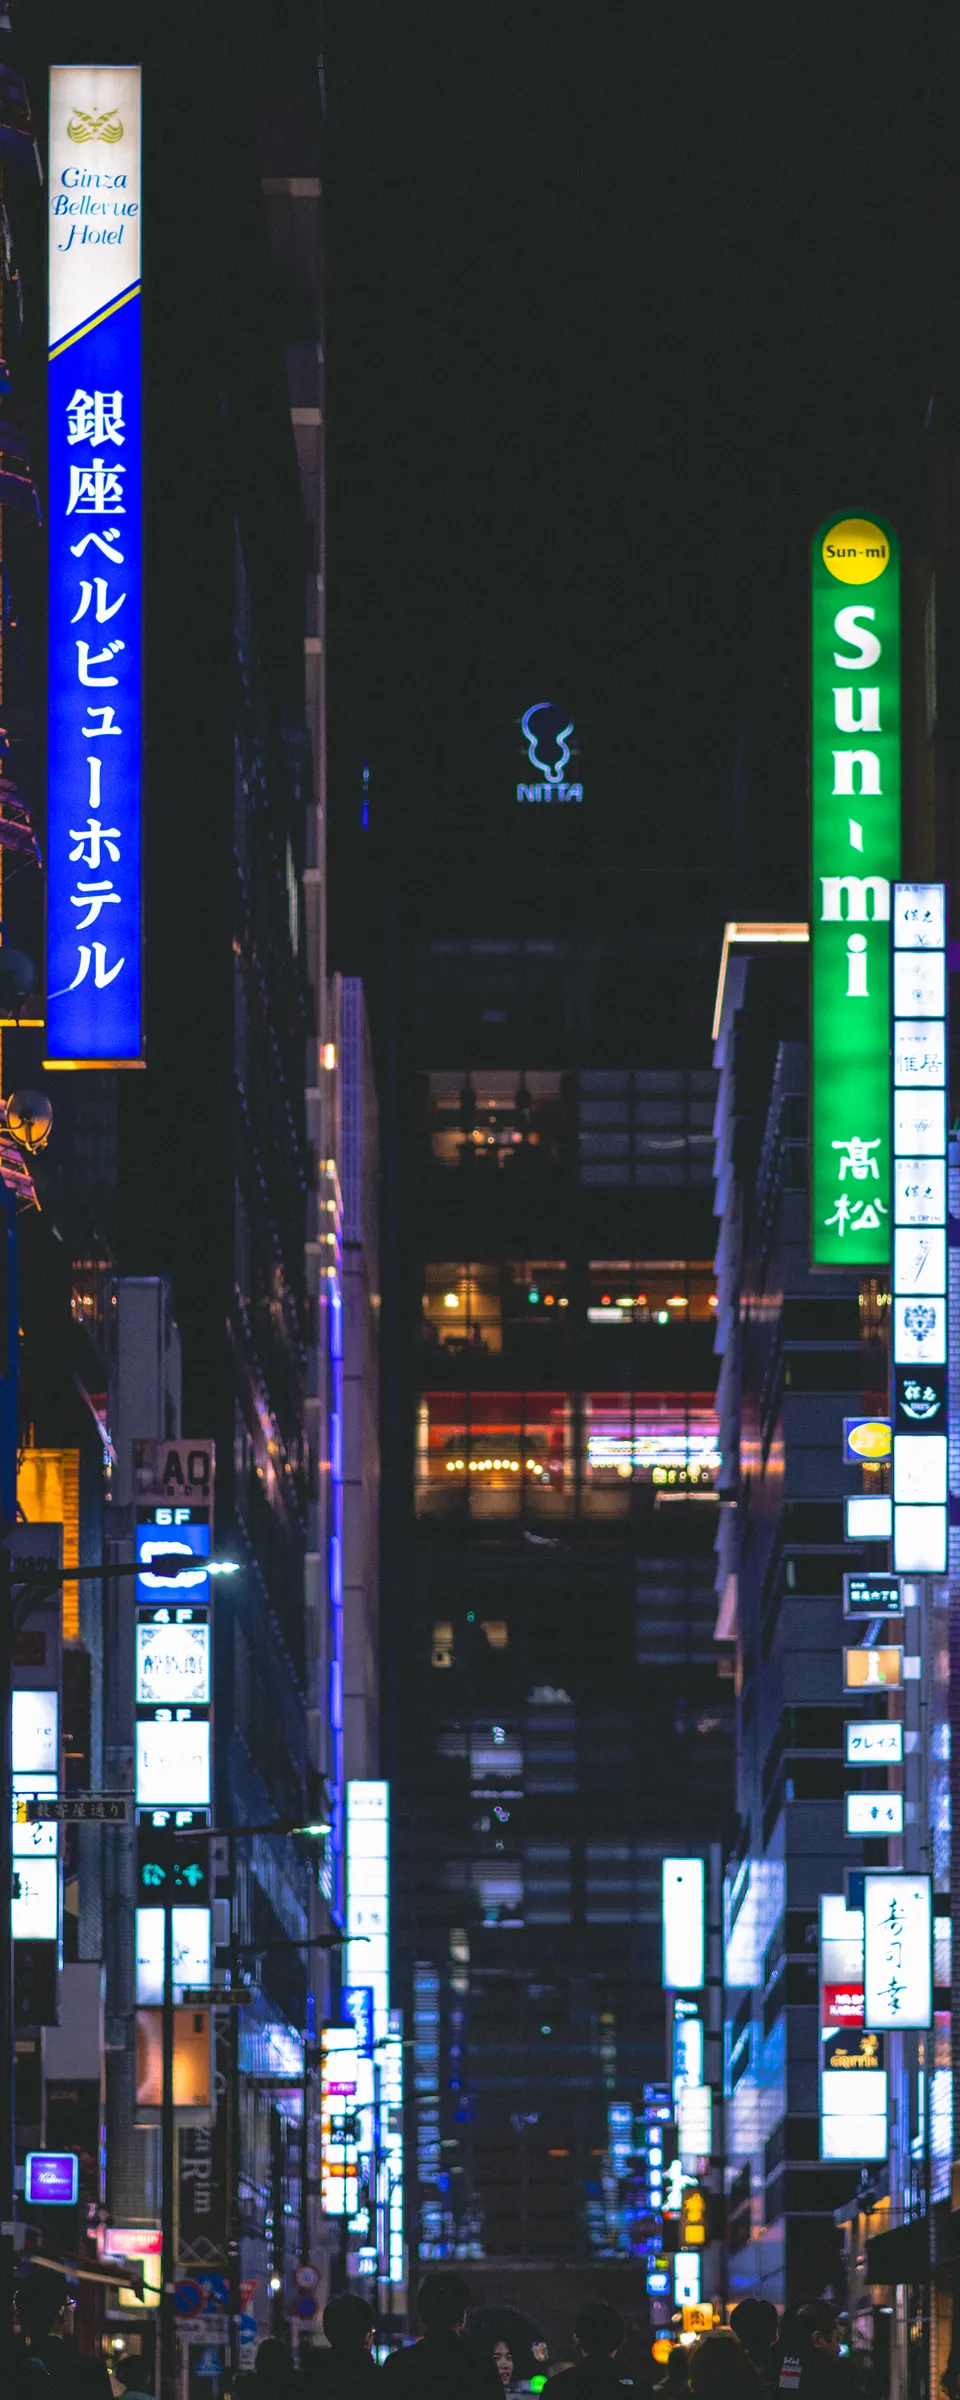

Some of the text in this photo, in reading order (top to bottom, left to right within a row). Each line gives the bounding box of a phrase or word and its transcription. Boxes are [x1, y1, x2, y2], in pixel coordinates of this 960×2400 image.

[61, 167, 127, 190] Ginza
[51, 195, 138, 217] Bellevue
[58, 223, 124, 251] Hotel
[826, 545, 886, 559] Sun-mi
[65, 388, 126, 990] 銀座ベルビューホテル
[517, 783, 584, 802] NITTA
[154, 1609, 193, 1624] 4F
[156, 1709, 191, 1722] 3F
[852, 1737, 897, 1748] グレイス
